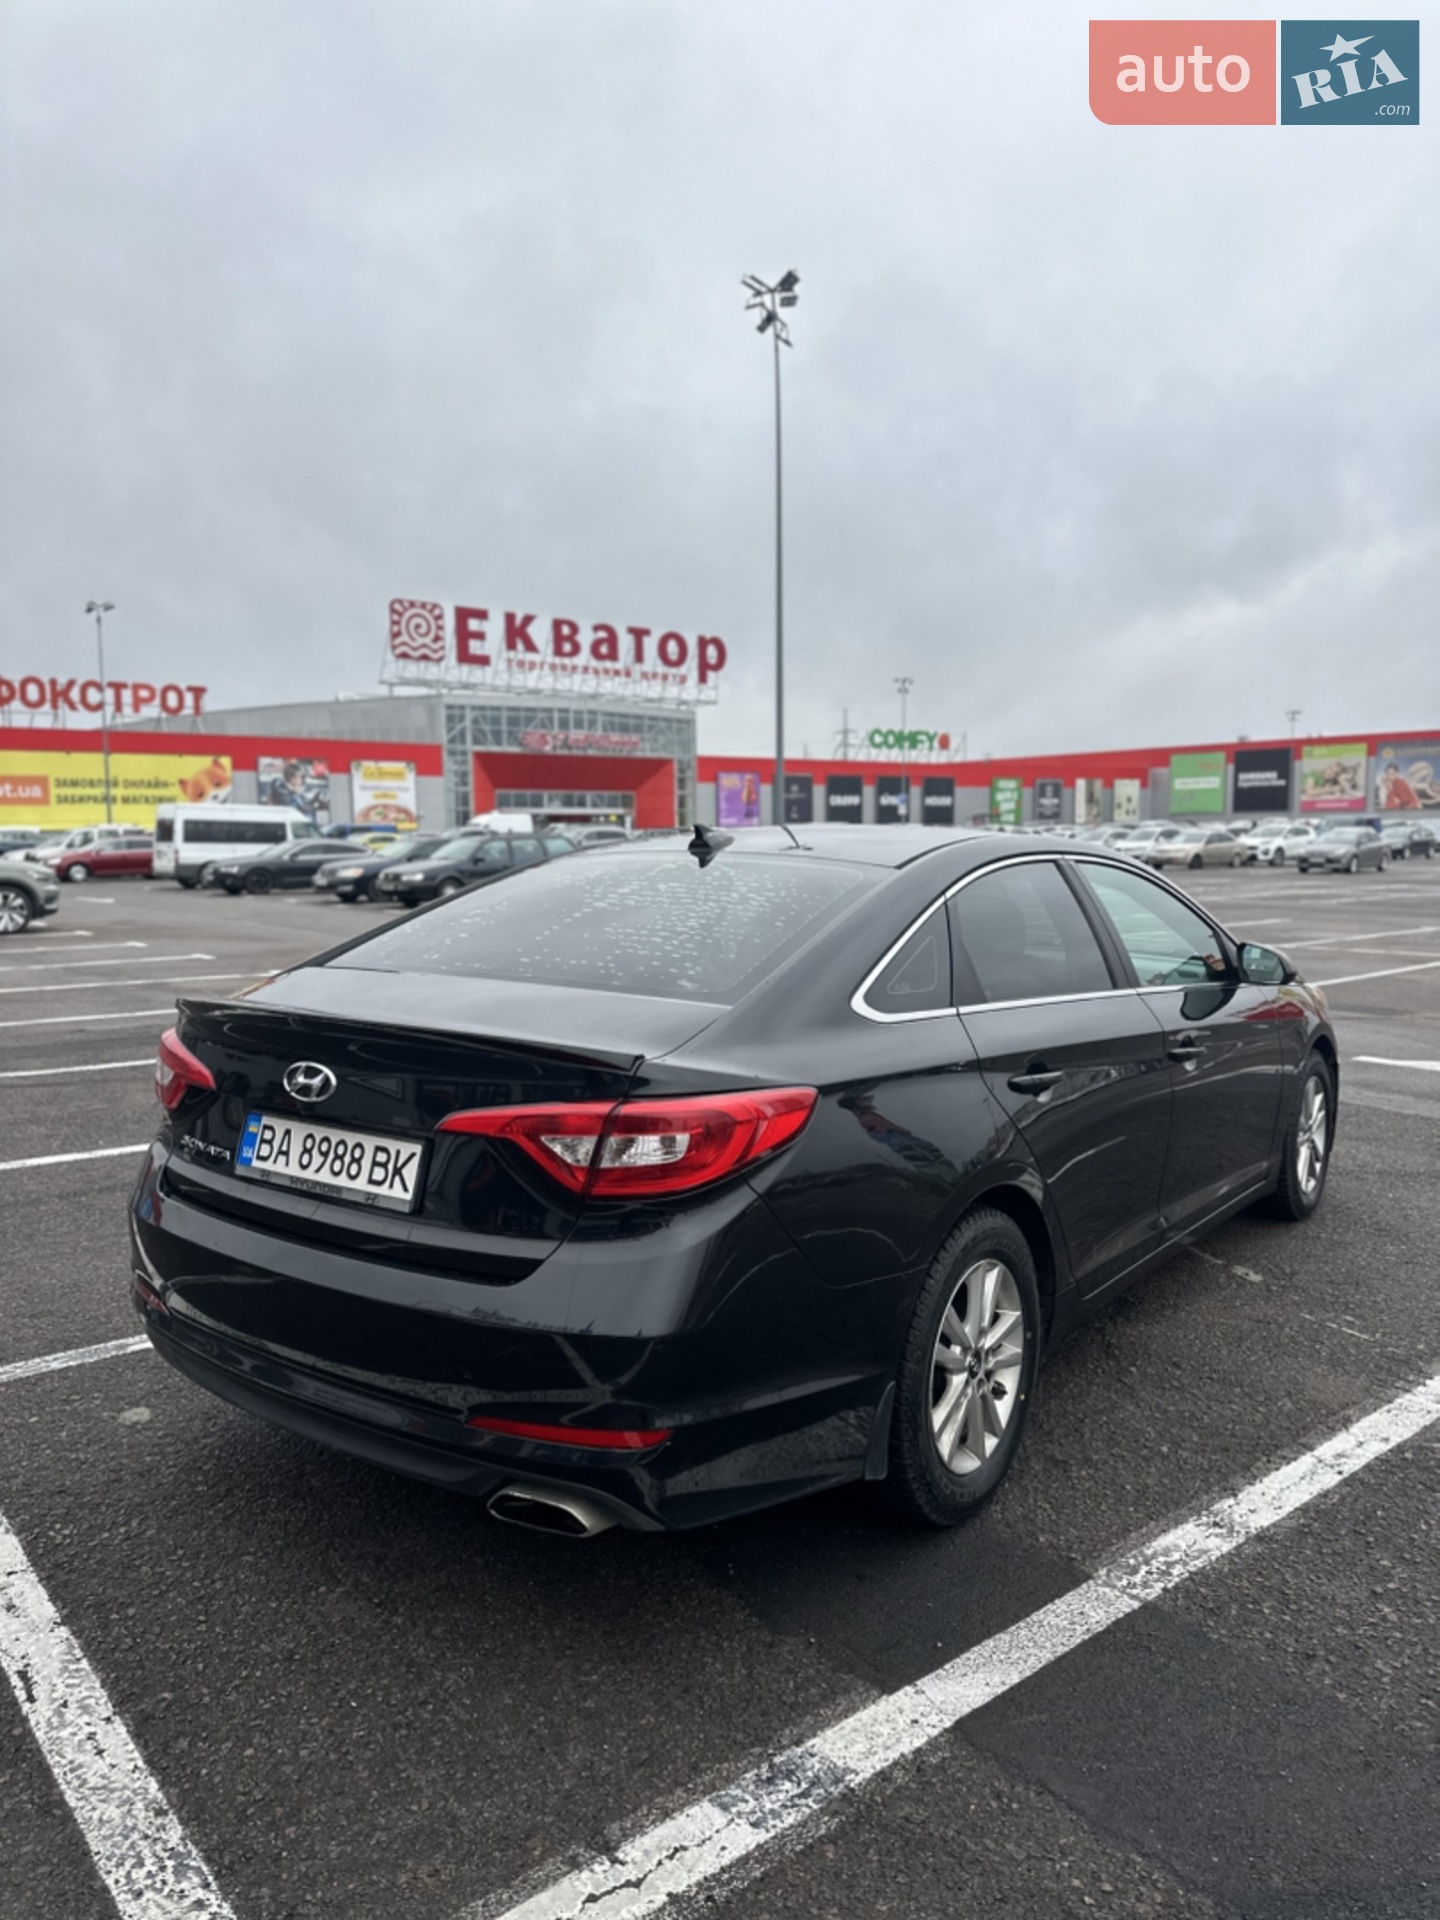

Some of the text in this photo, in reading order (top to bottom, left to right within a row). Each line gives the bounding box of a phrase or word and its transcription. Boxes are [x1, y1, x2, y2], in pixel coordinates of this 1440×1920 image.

[868, 728, 938, 751] COMFY
[255, 1123, 418, 1194] BA 8988 BK
[290, 1175, 343, 1198] HYUNDAI
